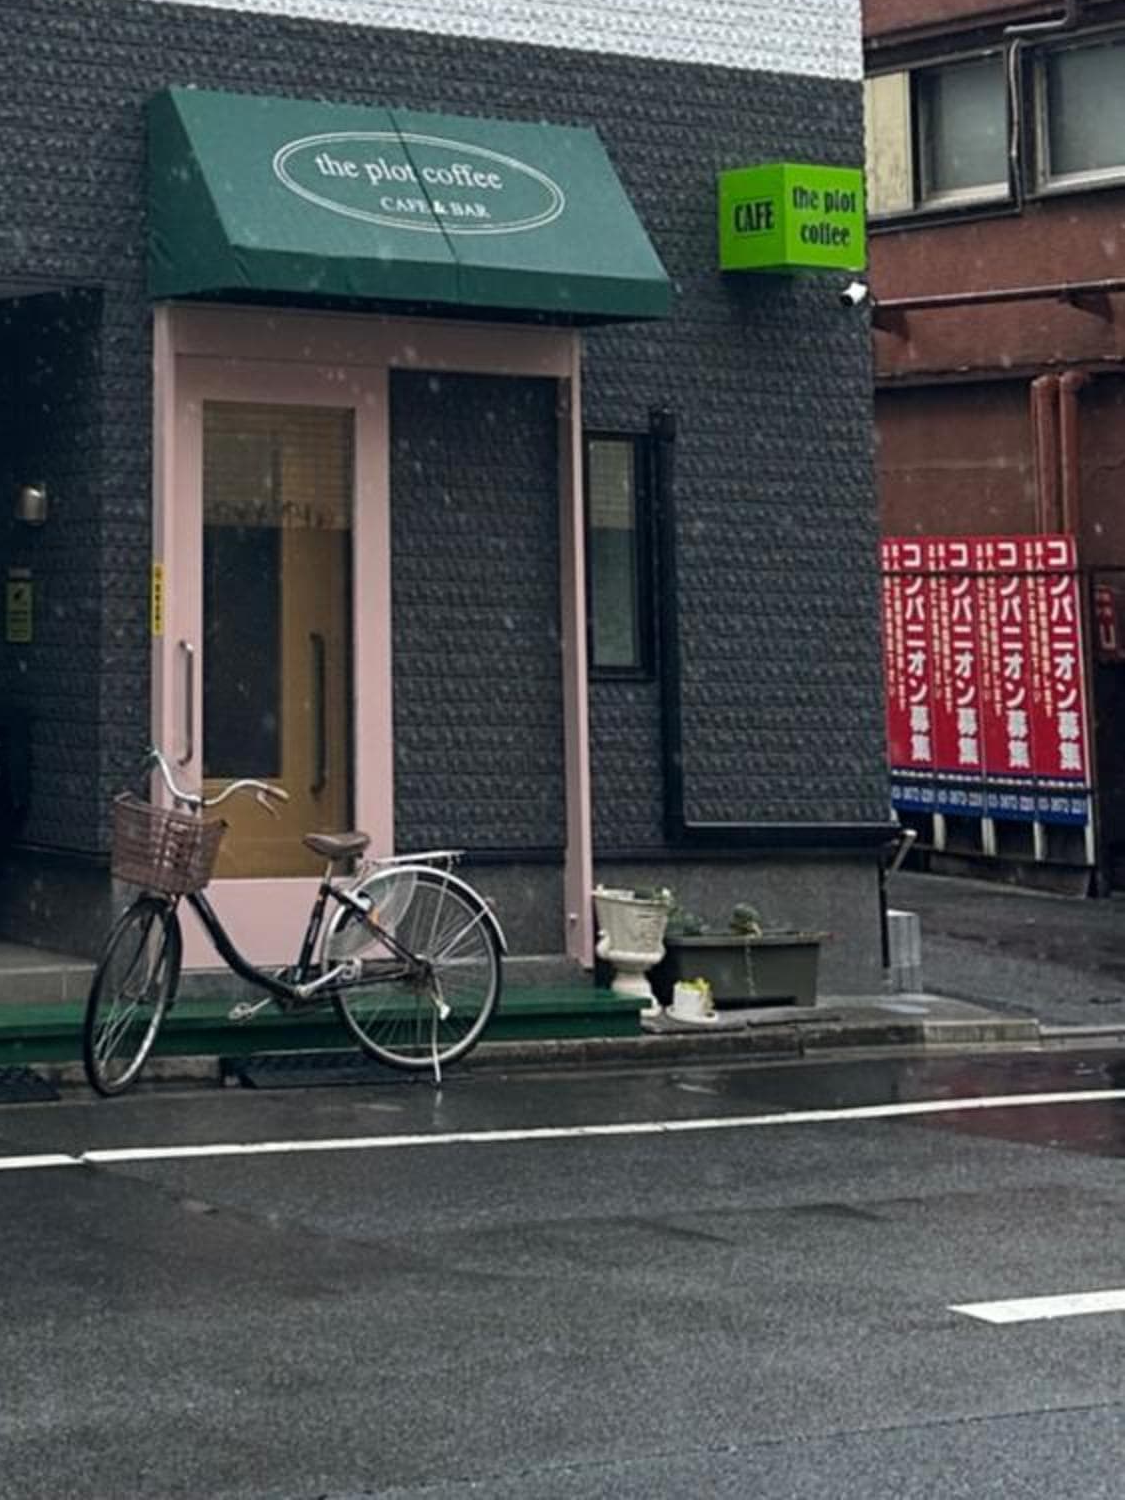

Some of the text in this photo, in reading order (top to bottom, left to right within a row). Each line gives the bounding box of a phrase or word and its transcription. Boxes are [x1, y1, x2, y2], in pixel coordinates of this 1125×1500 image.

[315, 152, 503, 189] the plot coffee
[449, 201, 491, 218] BAR
[792, 186, 856, 213] the plot
[734, 200, 774, 233] CAFE
[800, 223, 851, 246] coffee
